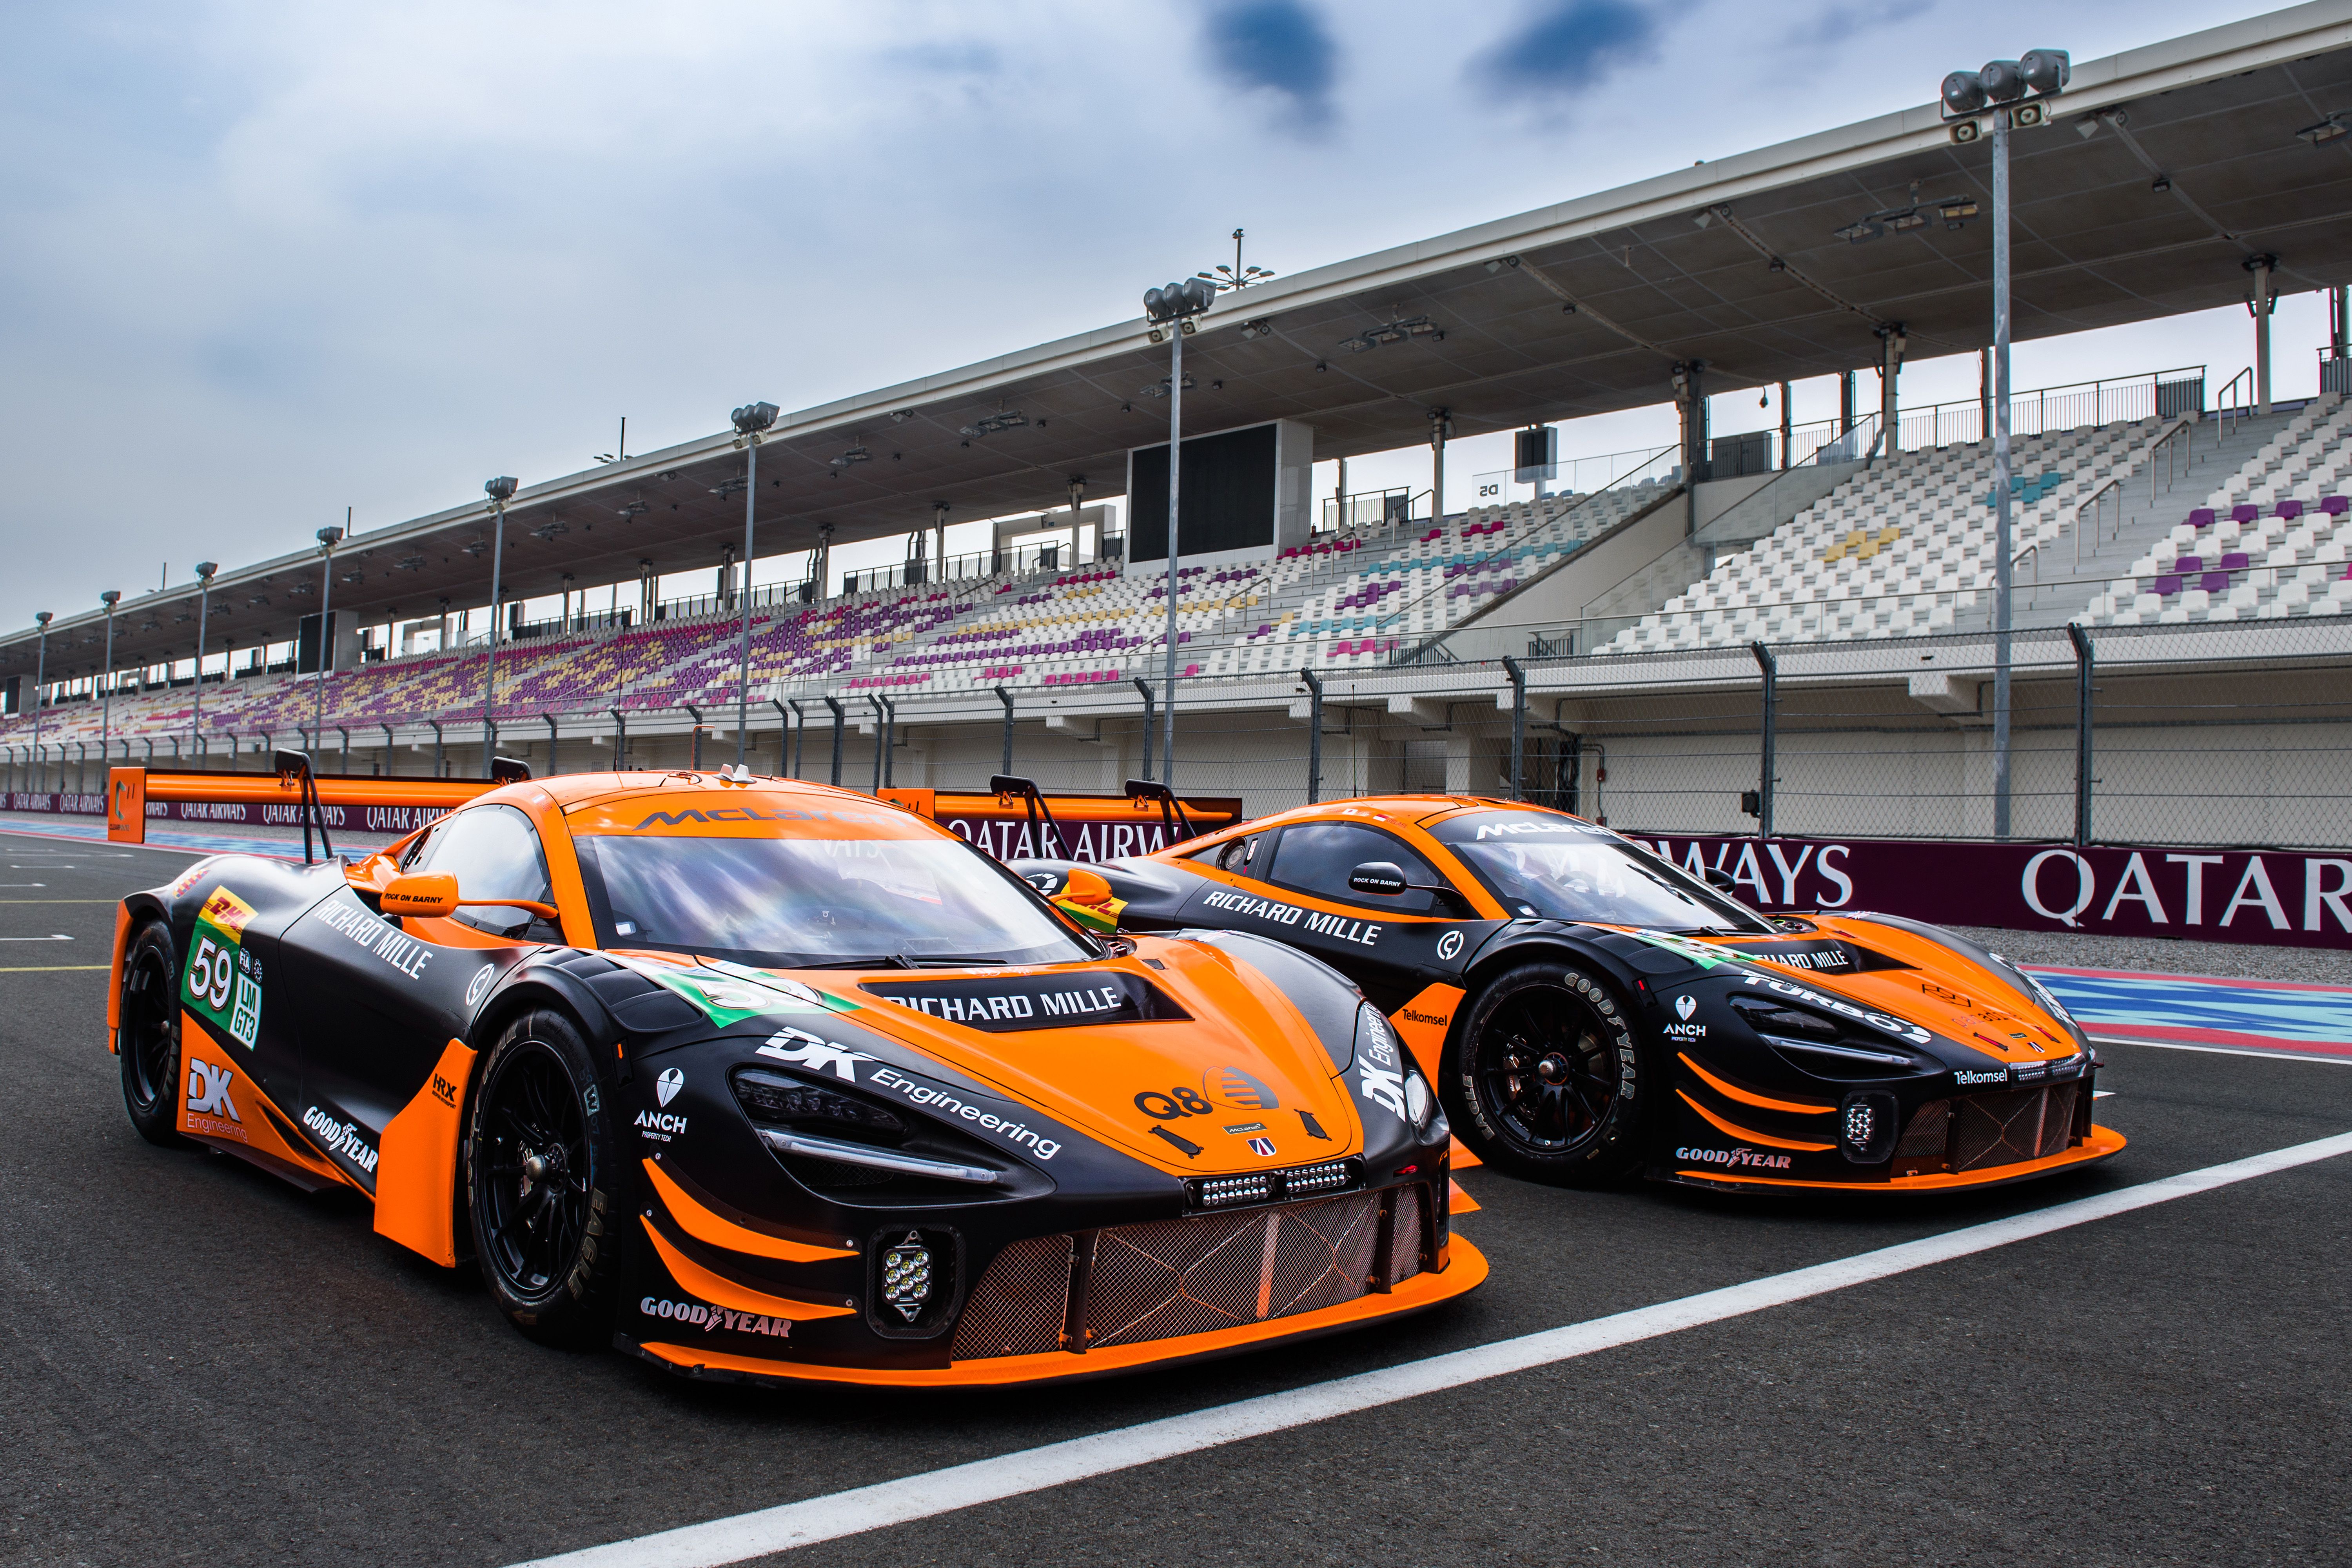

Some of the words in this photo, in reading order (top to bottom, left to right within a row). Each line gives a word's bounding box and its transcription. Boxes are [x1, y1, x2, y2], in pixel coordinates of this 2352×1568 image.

[14, 793, 29, 810] QATAR
[29, 794, 50, 811] AIRWAYS
[60, 795, 78, 813] QATAR
[79, 795, 103, 813] AIRWAYS
[181, 803, 208, 819] QATAR
[209, 803, 246, 820] AIRWAYS
[263, 805, 297, 824] QATAR
[367, 807, 410, 830] QATAR
[632, 808, 908, 831] McLaren
[412, 895, 444, 904] BARNY
[2022, 849, 2352, 934] QATAR
[209, 897, 247, 931] DHL
[1203, 891, 1303, 925] RICHARD
[1304, 912, 1381, 946] MILLE
[314, 899, 385, 947] RICHARD
[372, 930, 434, 980] MILLE
[189, 935, 232, 1011] 59
[1810, 950, 1849, 968] MILLE
[241, 980, 256, 1012] LM
[691, 977, 822, 1010] 59
[1043, 986, 1122, 1016] MILLE
[234, 1007, 256, 1042] GT3
[1403, 1009, 1447, 1026] Telkomsel
[1663, 1023, 1706, 1036] ANCH
[1361, 1001, 1394, 1066] Engineering
[1564, 973, 1635, 1099] GOODYEAR
[187, 1057, 241, 1124] DK
[433, 1073, 457, 1102] HRX
[1358, 1054, 1406, 1122] DK
[1954, 1068, 2007, 1085] Telkomsel
[755, 1026, 883, 1083] DK
[869, 1068, 1061, 1160] Engineering
[1134, 1087, 1213, 1120] Q8
[1463, 1073, 1495, 1140] EAGLE
[187, 1113, 248, 1143] Engineering
[634, 1110, 687, 1134] ANCH
[642, 1131, 661, 1140] PROPERTY
[661, 1134, 671, 1142] TECH
[1229, 1124, 1260, 1132] McLaren
[303, 1106, 378, 1173] GOODYEAR
[1676, 1147, 1791, 1169] GOODYEAR
[568, 1187, 608, 1300] EAGLE
[641, 1296, 792, 1338] GOODYEAR
